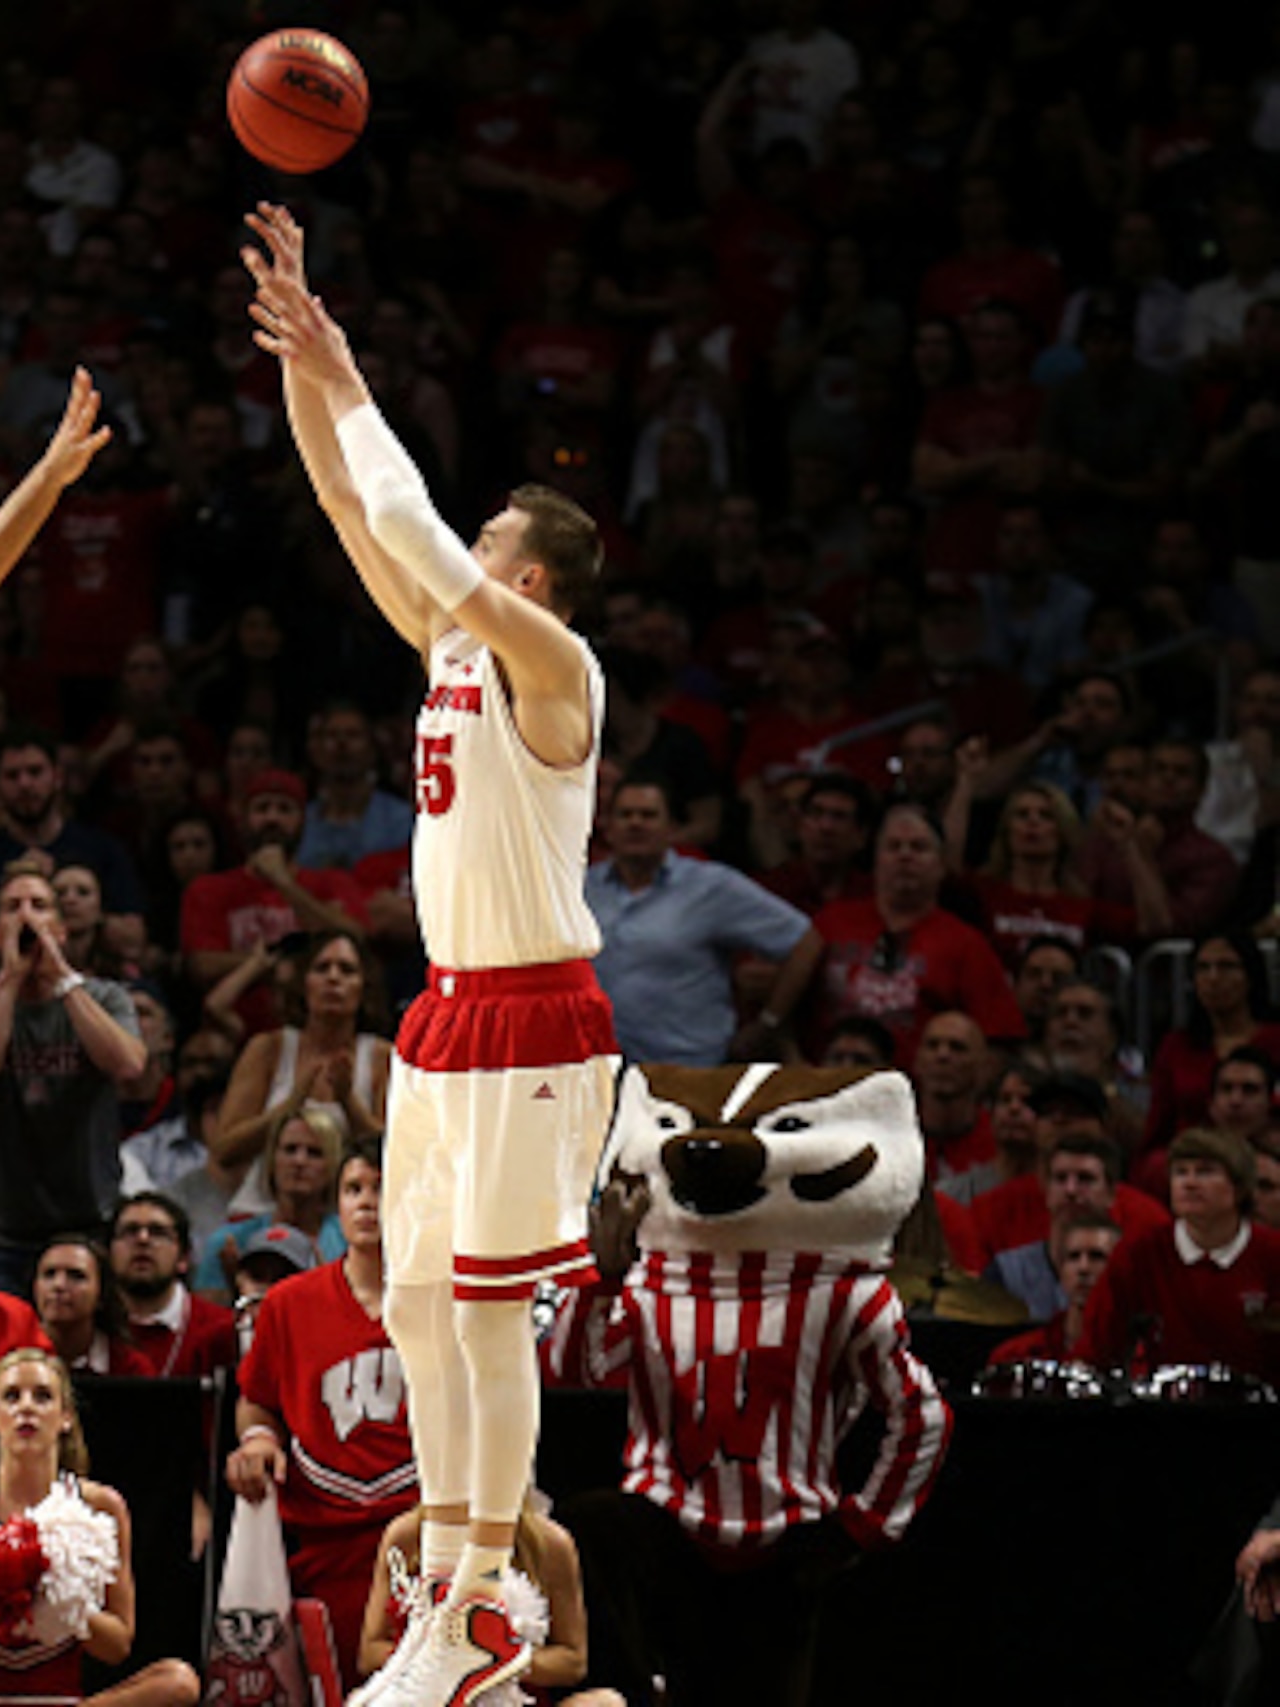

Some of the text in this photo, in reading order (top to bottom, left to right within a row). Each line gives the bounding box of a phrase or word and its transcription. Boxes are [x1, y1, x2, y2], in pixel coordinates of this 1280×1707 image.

[281, 64, 345, 109] NCAA
[321, 1345, 406, 1443] W
[673, 1346, 796, 1478] W
